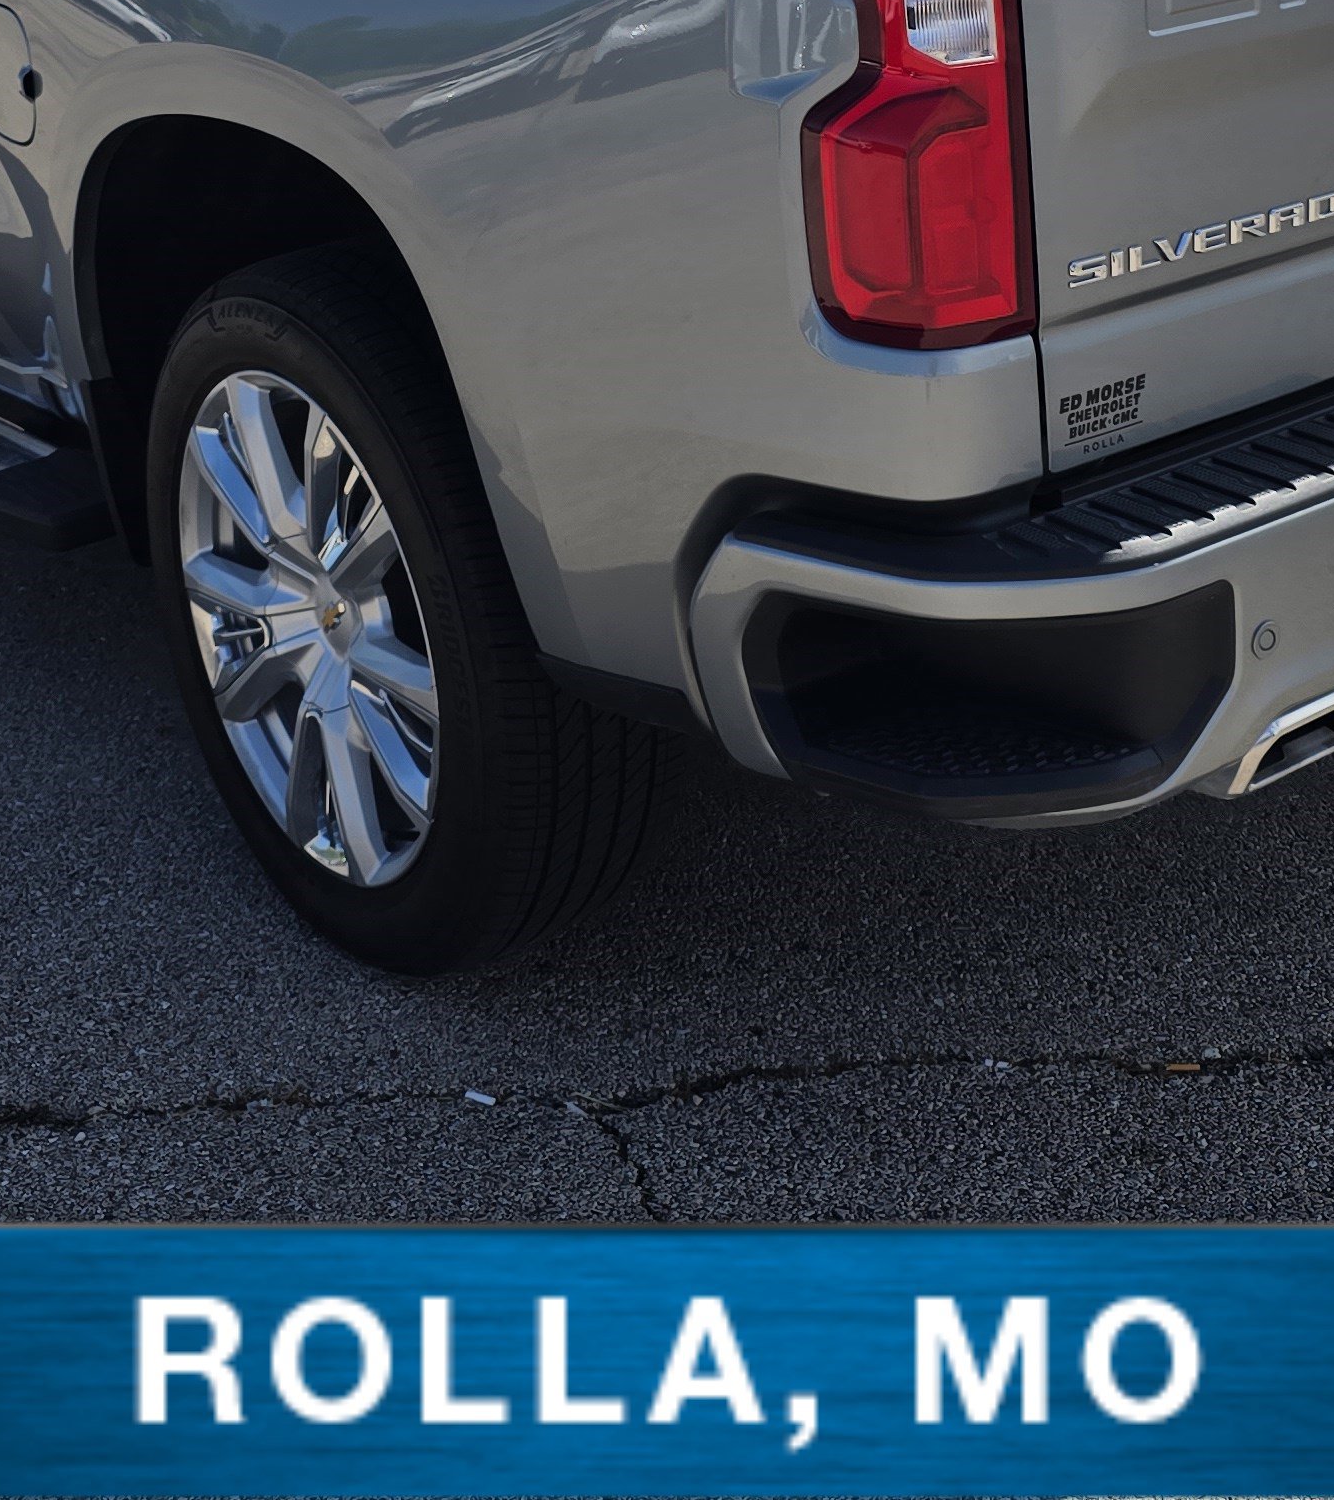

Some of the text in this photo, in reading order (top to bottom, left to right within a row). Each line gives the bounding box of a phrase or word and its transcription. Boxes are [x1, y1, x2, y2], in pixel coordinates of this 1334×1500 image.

[1059, 373, 1146, 415] ED MORSE
[1067, 392, 1141, 426] CHEVROLET
[1083, 433, 1125, 455] ROLLA
